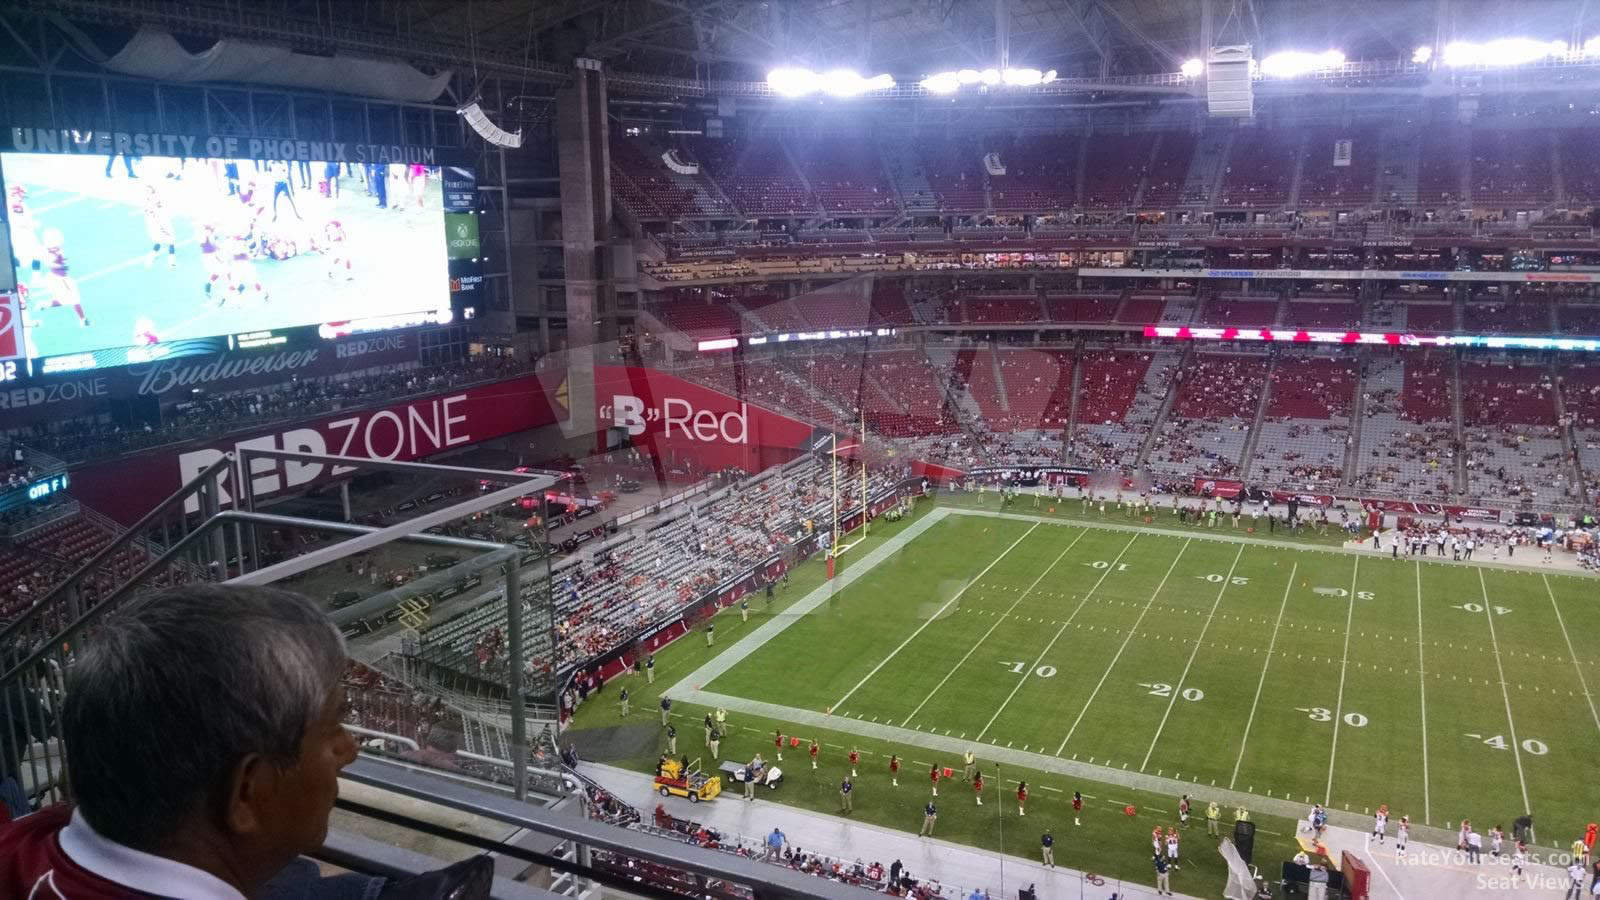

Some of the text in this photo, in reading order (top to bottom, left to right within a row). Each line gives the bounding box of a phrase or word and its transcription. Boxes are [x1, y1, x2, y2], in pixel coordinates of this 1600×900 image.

[12, 127, 435, 164] UNIVERSITY OF PHOENIX STADIUM
[336, 334, 406, 358] REDZONE
[128, 348, 319, 395] Budweiser
[664, 398, 748, 444] Red
[179, 395, 471, 514] REDZONE
[1008, 661, 1058, 678] 10
[1148, 683, 1205, 702] 20
[1308, 707, 1369, 728] 30
[1482, 735, 1549, 756] 40
